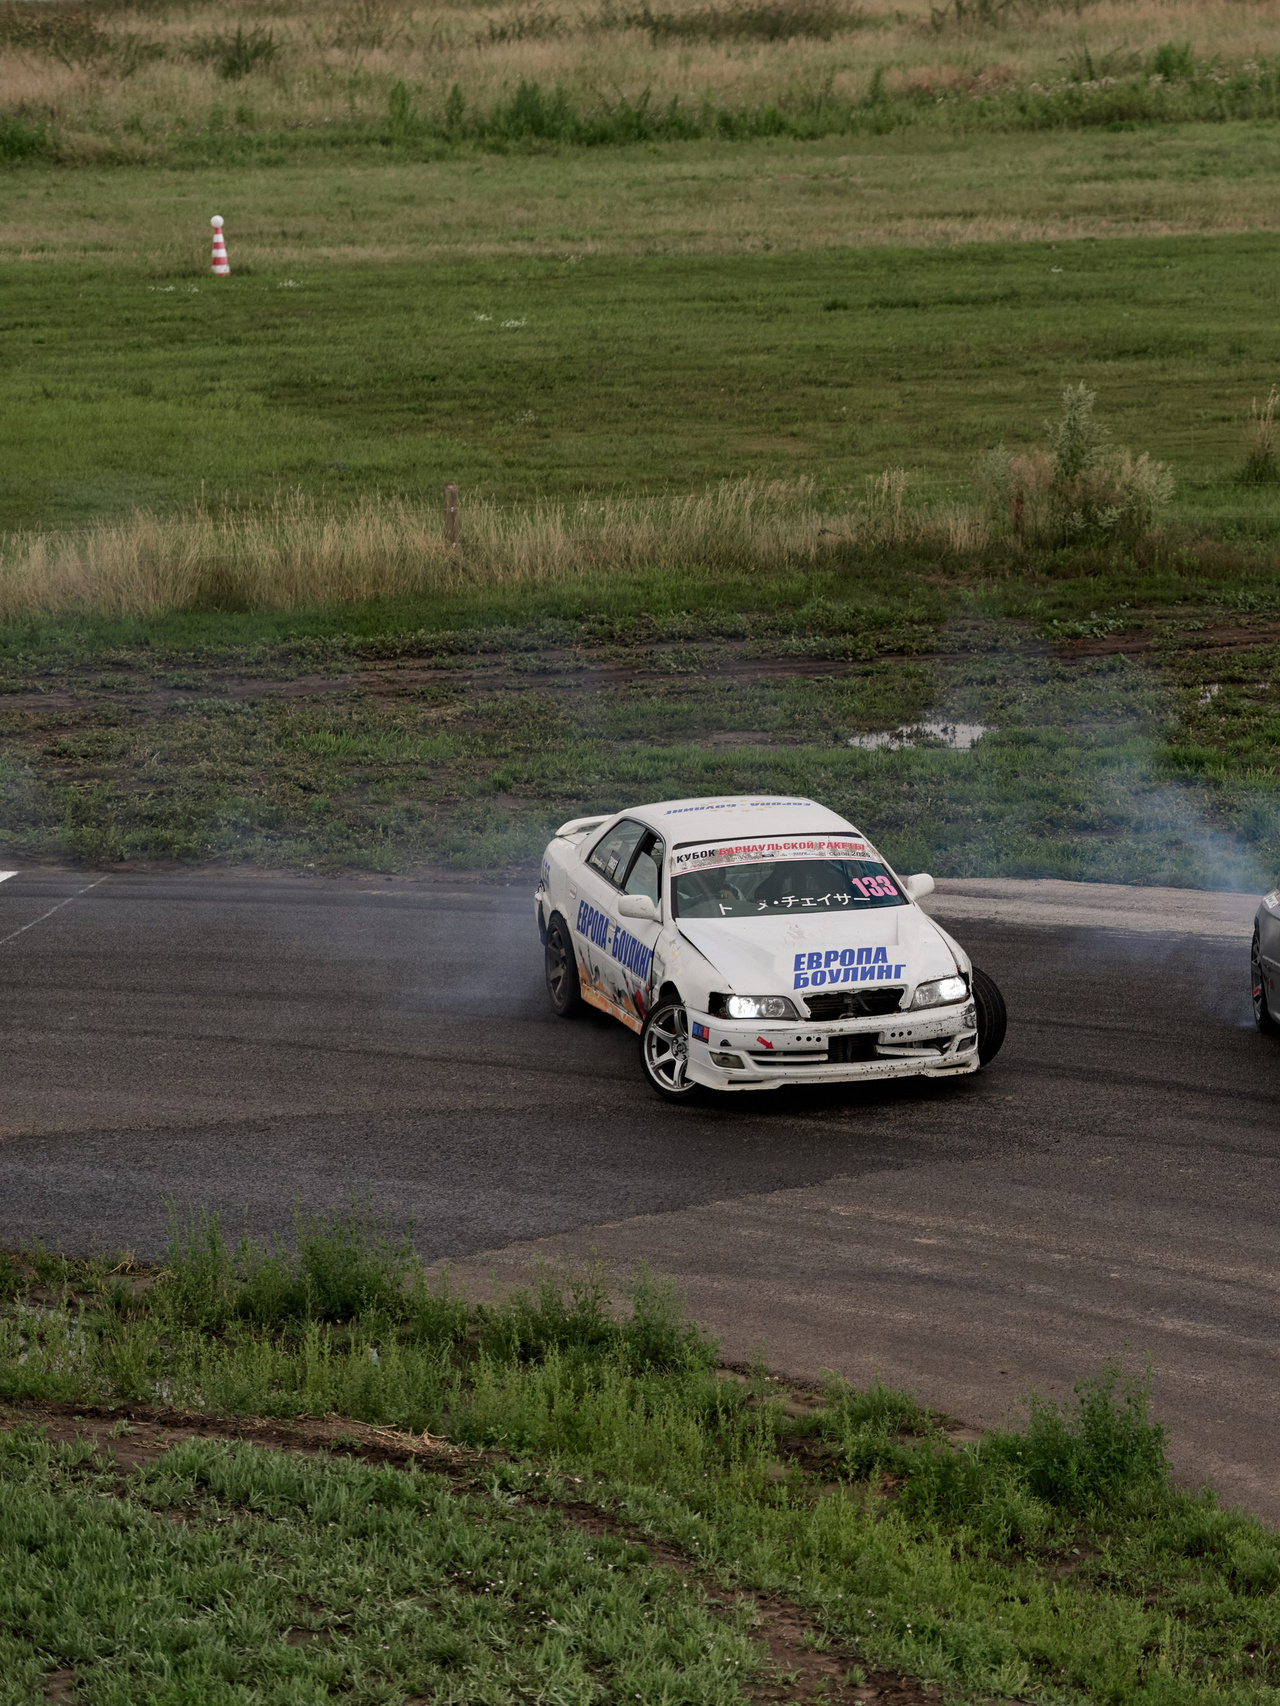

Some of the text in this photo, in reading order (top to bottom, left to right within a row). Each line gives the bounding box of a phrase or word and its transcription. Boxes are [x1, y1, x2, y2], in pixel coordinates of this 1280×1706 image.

[676, 848, 717, 864] КУБОК
[719, 840, 814, 856] БАРНАУЛЬСКОЙ
[818, 841, 866, 851] РАКЕТЫ
[851, 875, 898, 898] 133
[576, 899, 610, 950] ЕВРОПА
[611, 925, 655, 982] БОУЛИНГ
[793, 946, 888, 972] ЕВРОПА
[793, 964, 907, 990] БОУЛИНГ
